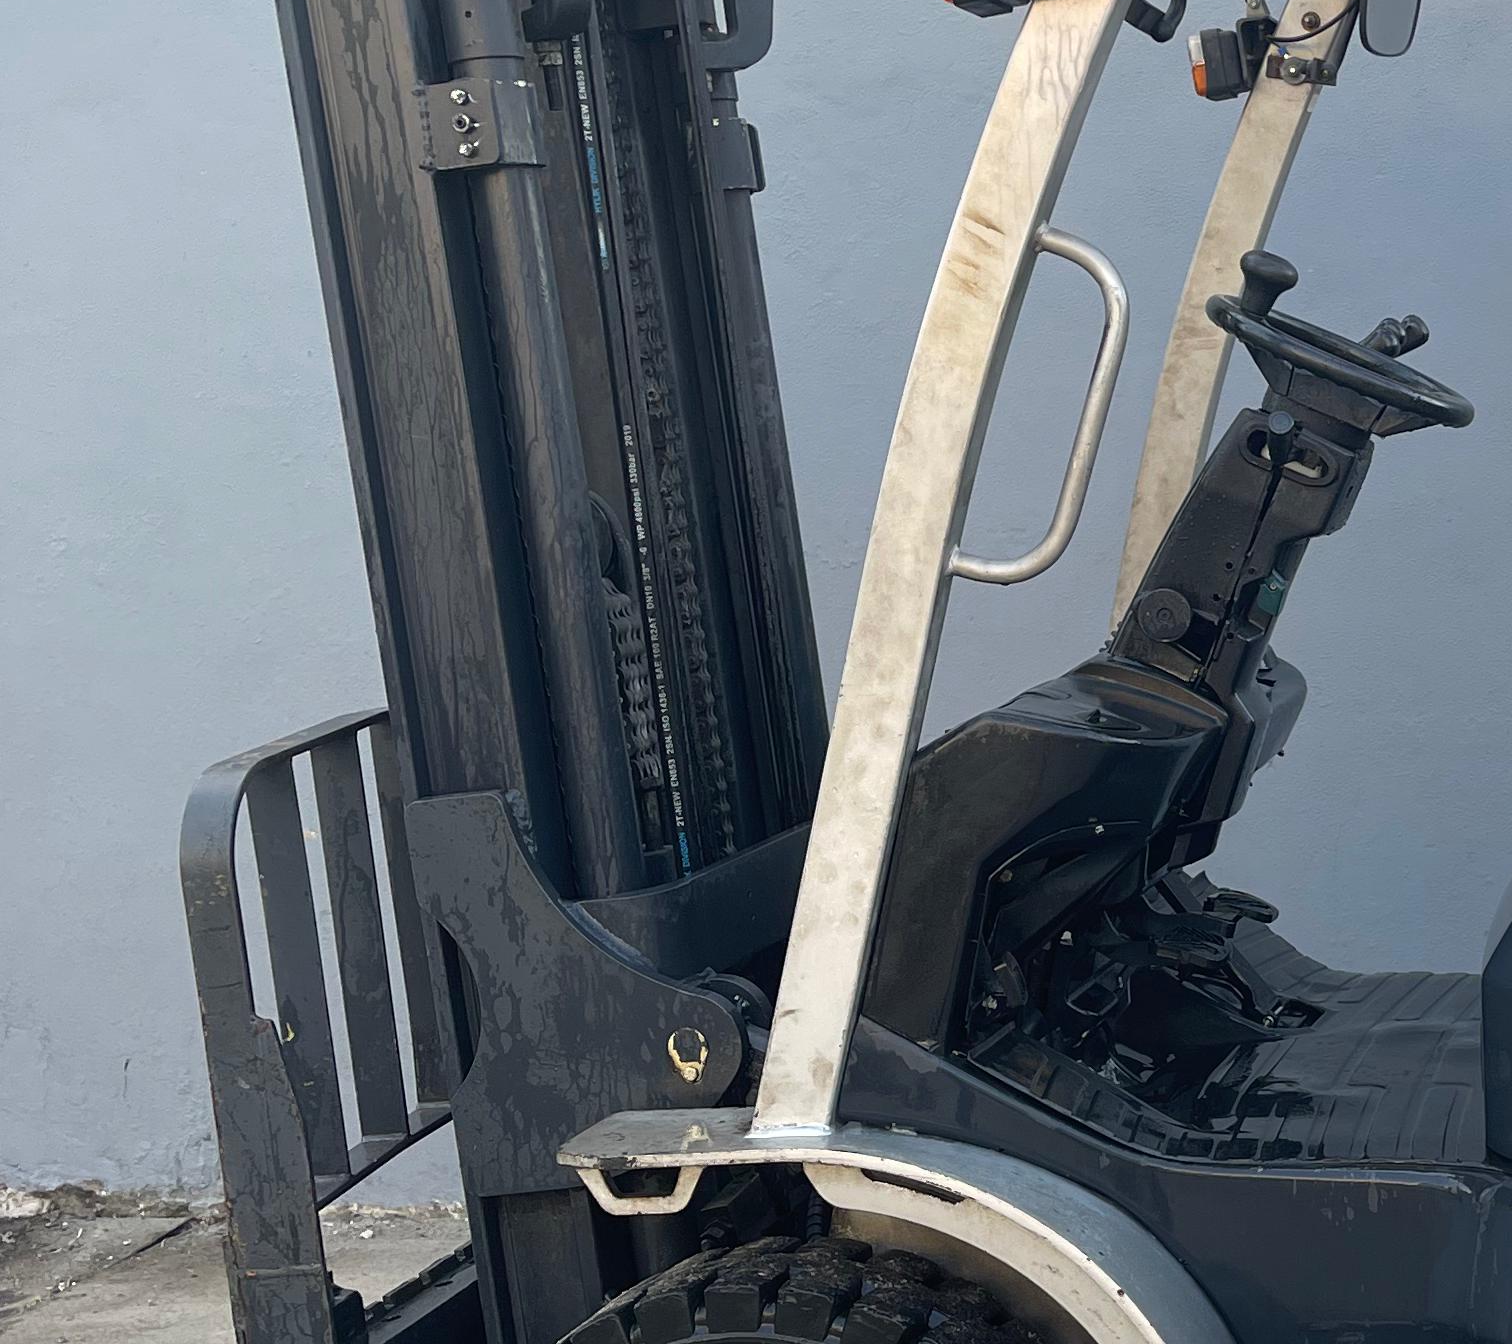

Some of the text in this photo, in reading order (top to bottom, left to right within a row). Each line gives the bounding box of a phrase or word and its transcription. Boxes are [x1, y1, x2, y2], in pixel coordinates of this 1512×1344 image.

[627, 453, 639, 484] 330bar
[636, 524, 646, 540] WP
[653, 660, 664, 680] SAE
[662, 715, 672, 732] ISO
